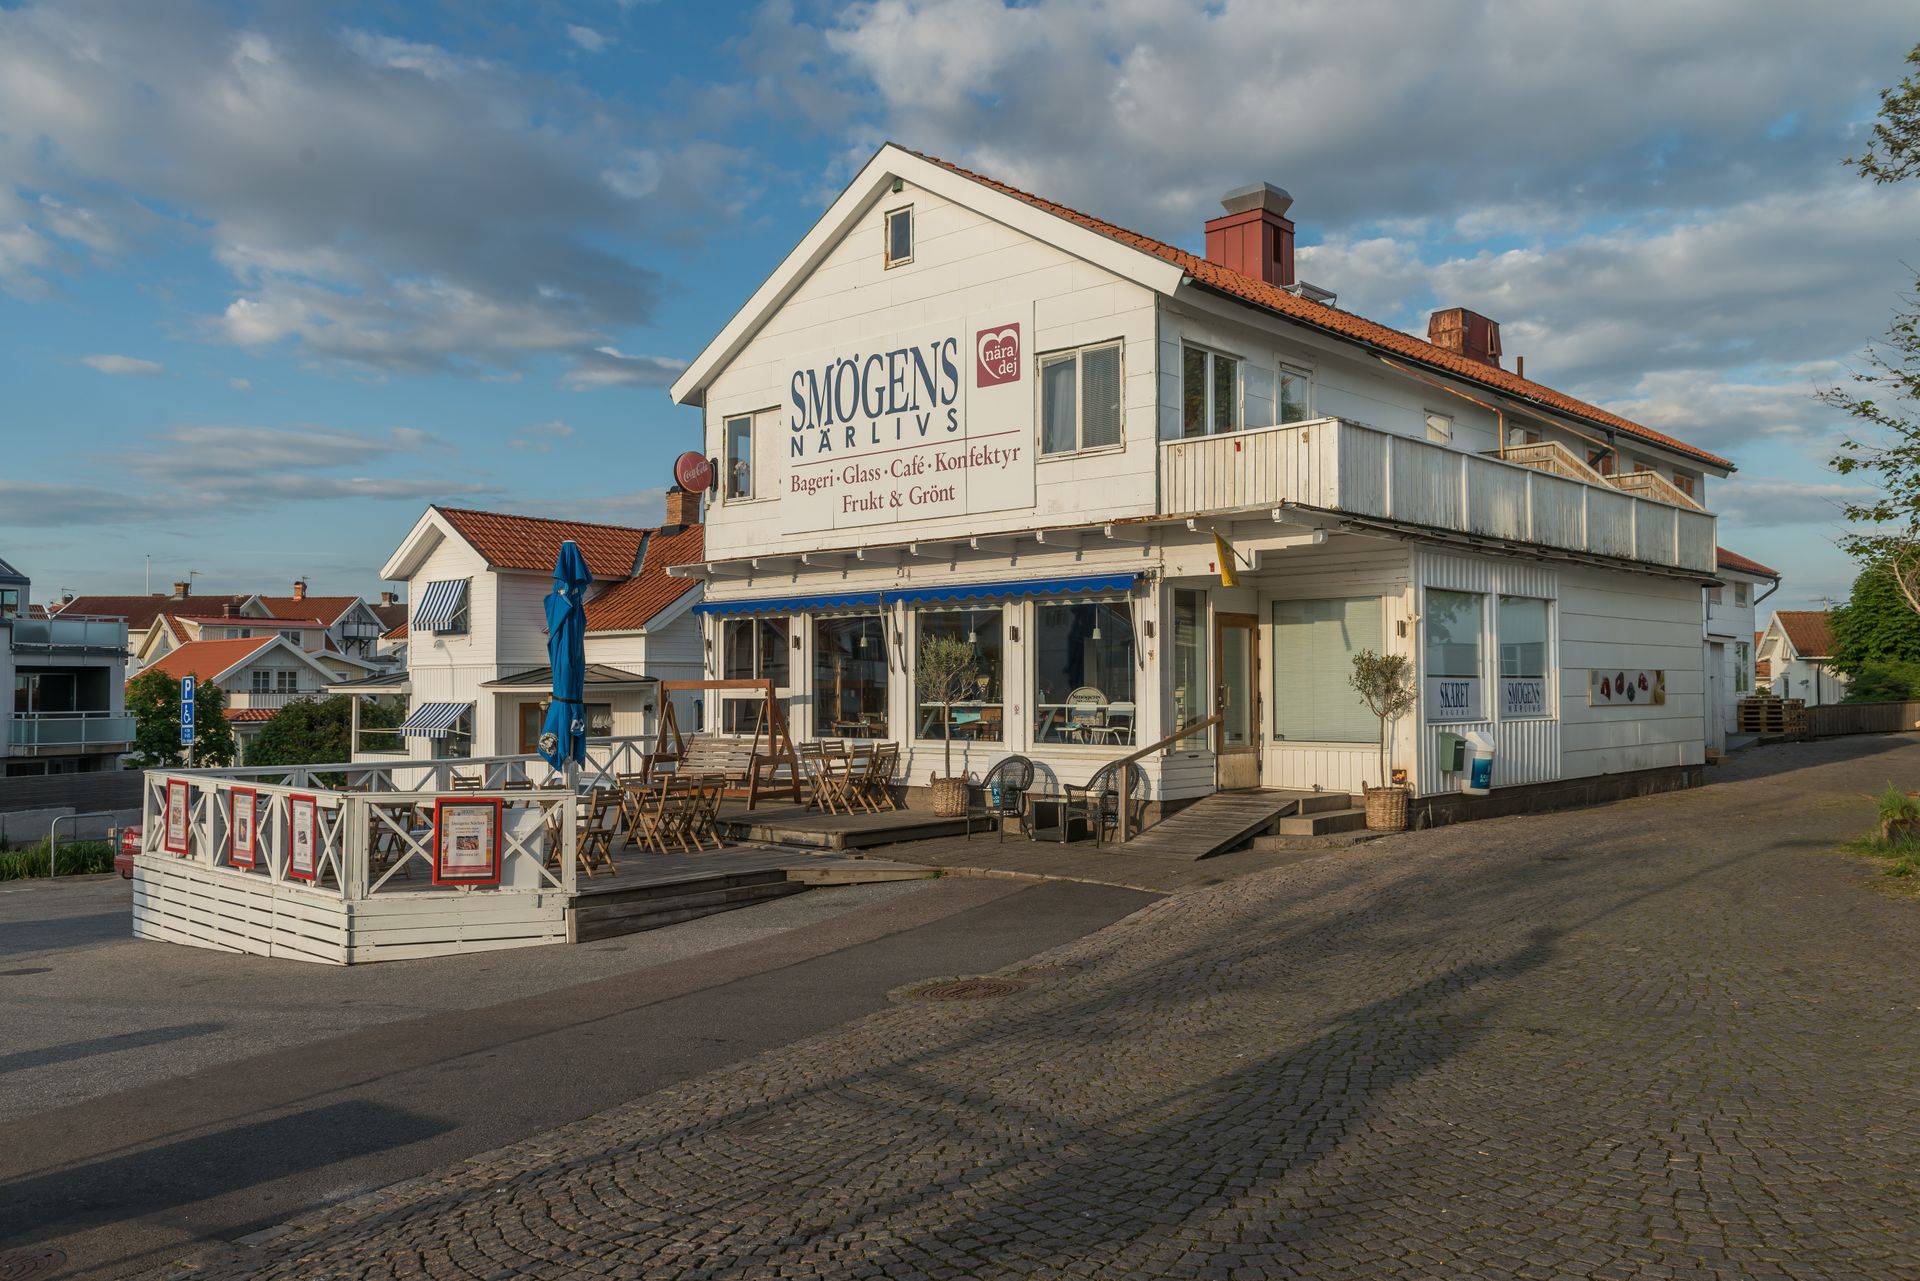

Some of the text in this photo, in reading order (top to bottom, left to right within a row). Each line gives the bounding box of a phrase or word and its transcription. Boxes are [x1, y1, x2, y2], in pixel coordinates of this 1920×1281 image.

[985, 344, 1014, 362] nära
[998, 358, 1018, 376] dej
[791, 337, 959, 433] SMÖGENS
[791, 408, 959, 457] NÄRLIVS
[791, 445, 1020, 496] Bageri Glass Café Konfektyr
[842, 484, 955, 513] Frukt & Grönt
[184, 679, 191, 699] P
